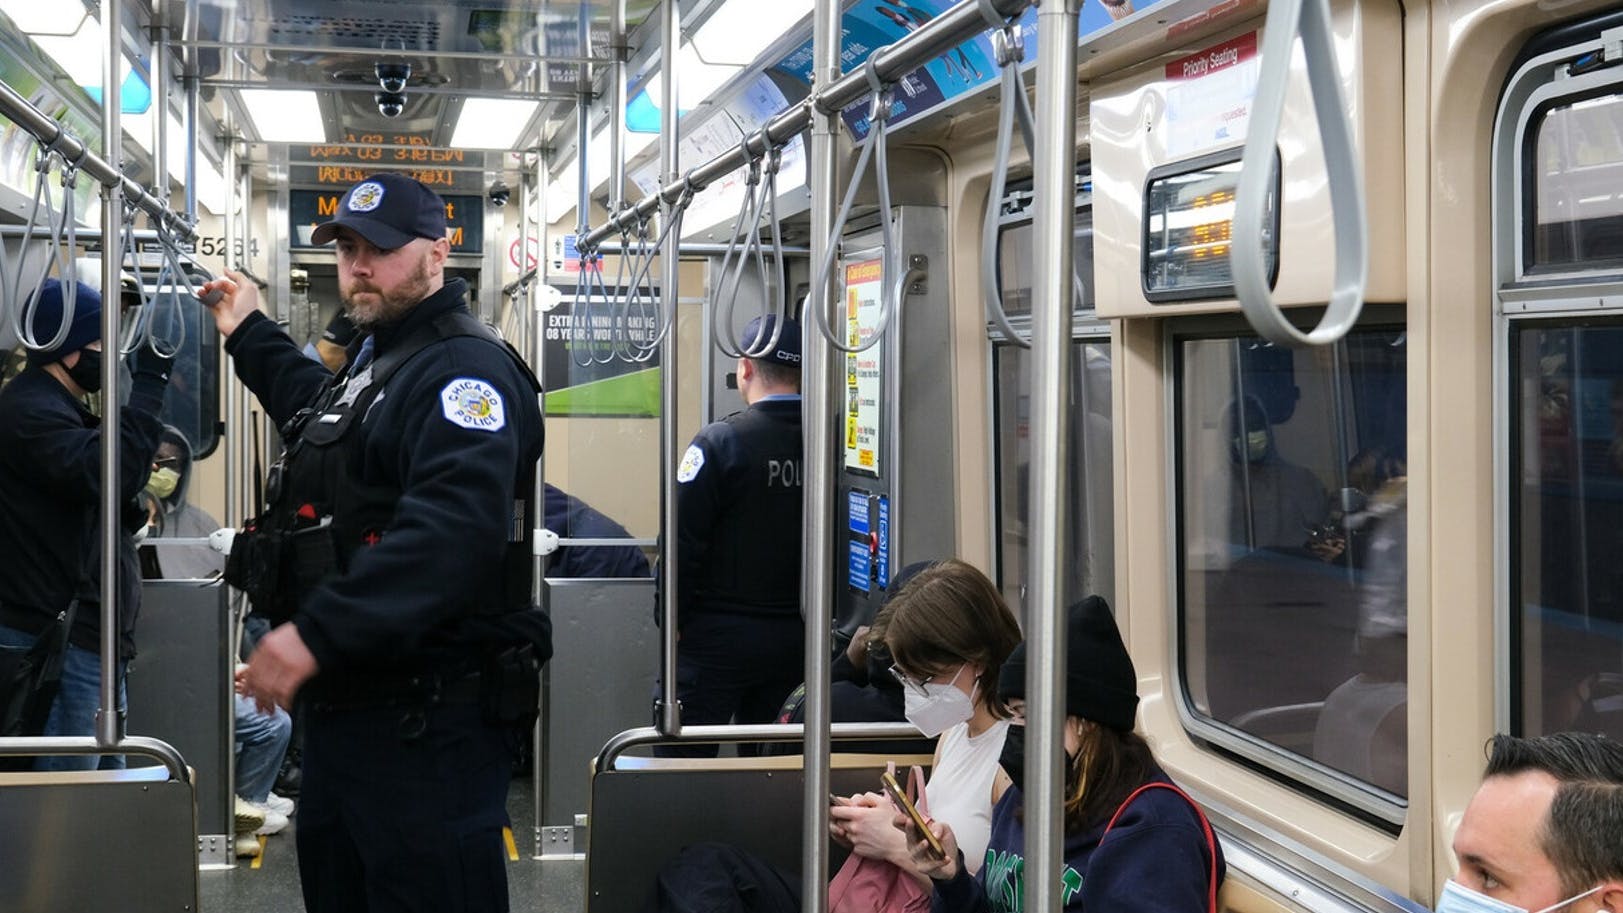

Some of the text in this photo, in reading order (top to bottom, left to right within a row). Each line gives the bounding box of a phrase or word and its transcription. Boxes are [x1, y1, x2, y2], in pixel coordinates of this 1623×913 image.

[1183, 47, 1238, 77] Priority Seating
[548, 315, 580, 328] EXTRA
[776, 350, 801, 362] CPD
[448, 381, 498, 406] CHICAGO
[454, 409, 498, 426] POLICE
